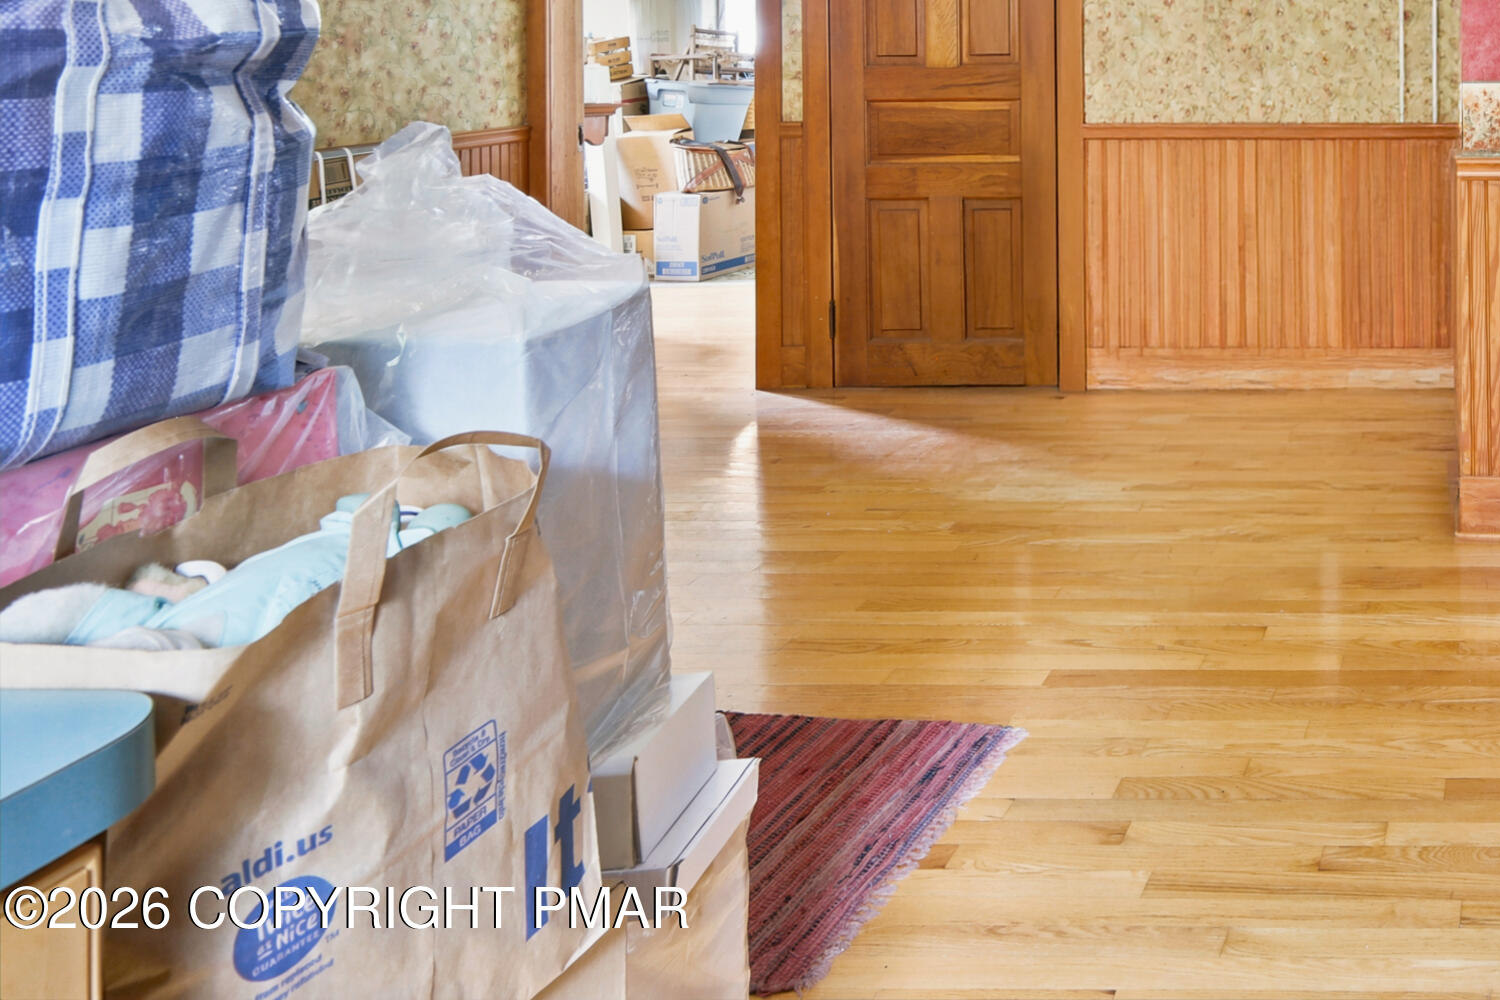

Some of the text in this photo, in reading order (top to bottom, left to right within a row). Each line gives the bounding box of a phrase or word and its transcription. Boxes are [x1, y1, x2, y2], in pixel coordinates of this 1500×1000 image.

[453, 805, 488, 838] PAPER
[458, 823, 482, 848] BAG
[220, 824, 334, 897] aldi.us
[523, 778, 593, 942] It
[251, 929, 321, 978] GUARANTEE
